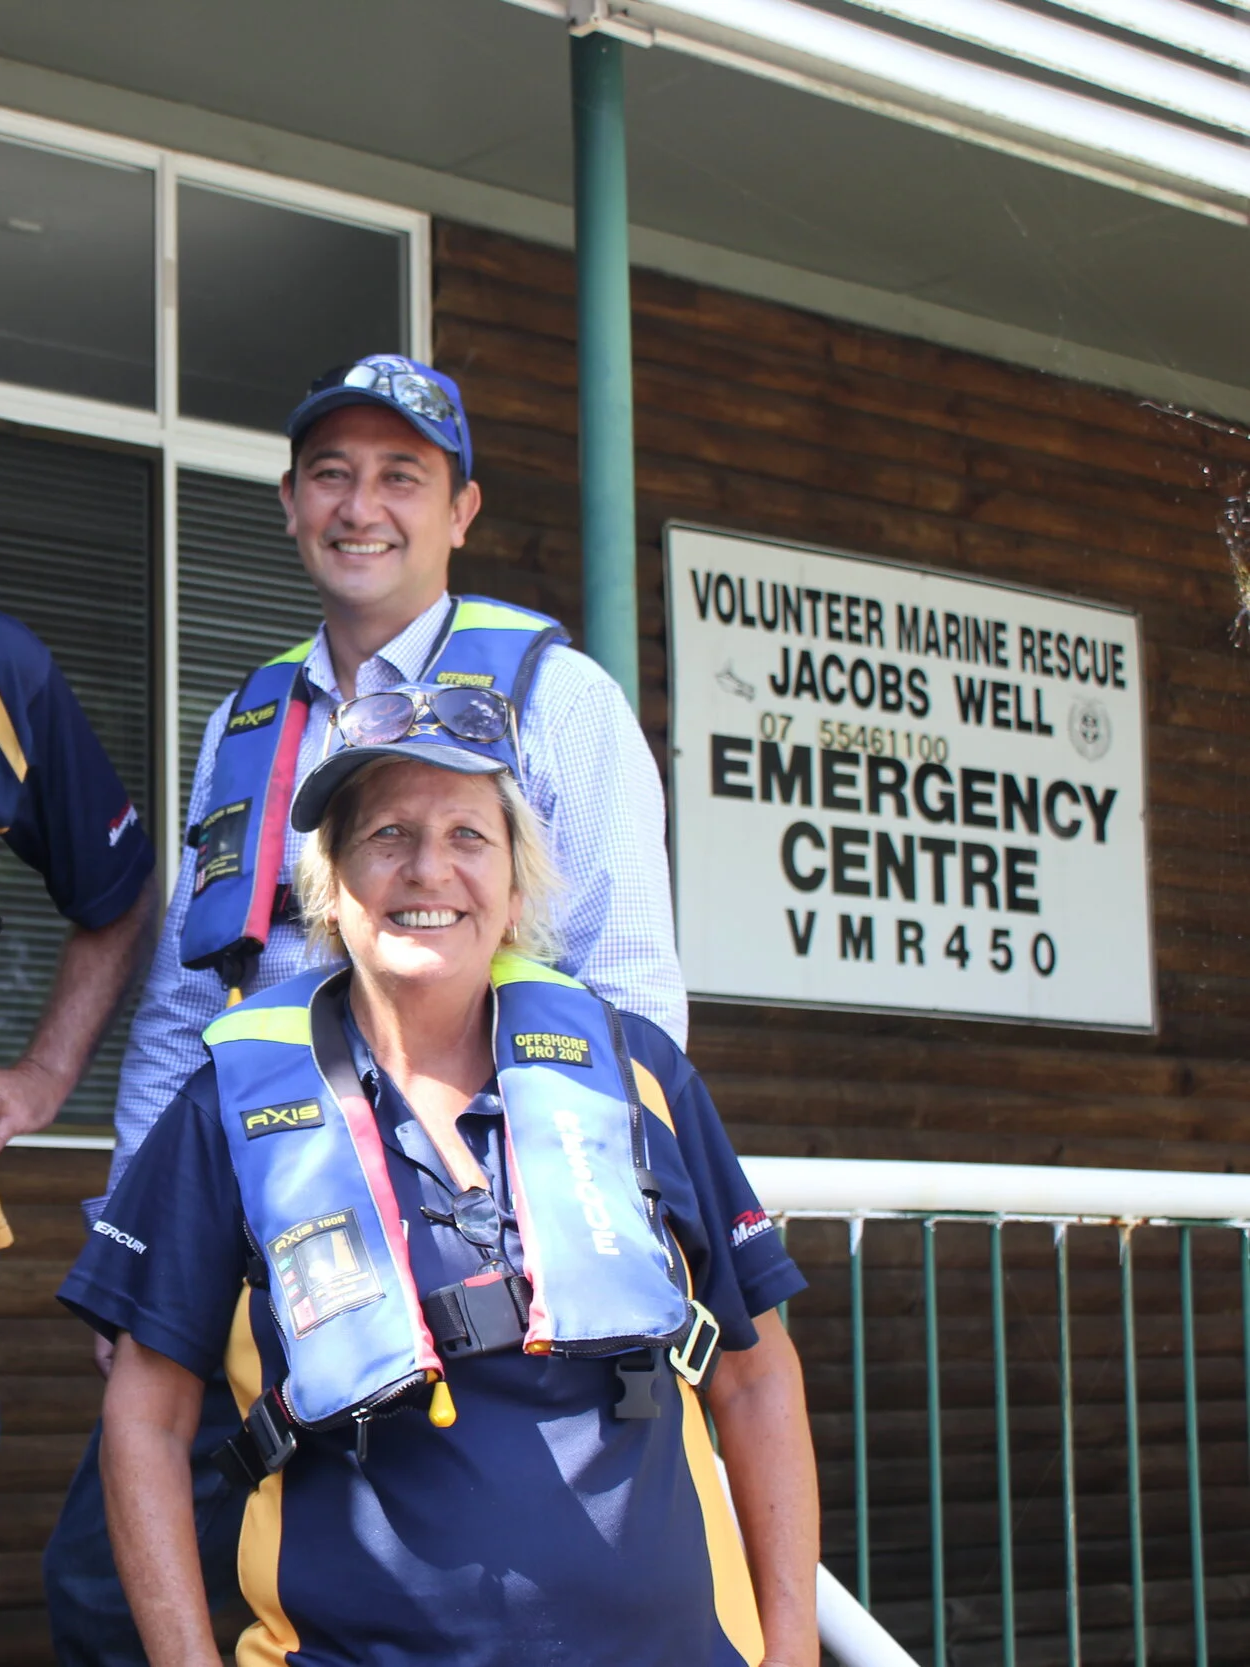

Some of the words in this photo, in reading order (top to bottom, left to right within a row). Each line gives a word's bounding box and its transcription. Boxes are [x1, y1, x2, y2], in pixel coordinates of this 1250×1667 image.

[690, 569, 884, 648] VOLUNTEER
[897, 604, 1009, 669] MARINE
[1019, 626, 1126, 690] RESCUE
[436, 671, 494, 687] OFFSHORE
[769, 647, 930, 719] JACOBS
[953, 675, 1053, 736] WELL
[229, 704, 276, 728] AXIS
[760, 712, 793, 741] 07
[819, 719, 948, 763] 55461100
[711, 733, 1118, 843] EMERGENCY
[781, 821, 1040, 914] CENTRE
[515, 1033, 589, 1052] OFFSHORE
[525, 1046, 555, 1058] PRO
[557, 1047, 583, 1062] 200
[246, 1104, 320, 1129] AXIS
[274, 1223, 314, 1254] AXIS
